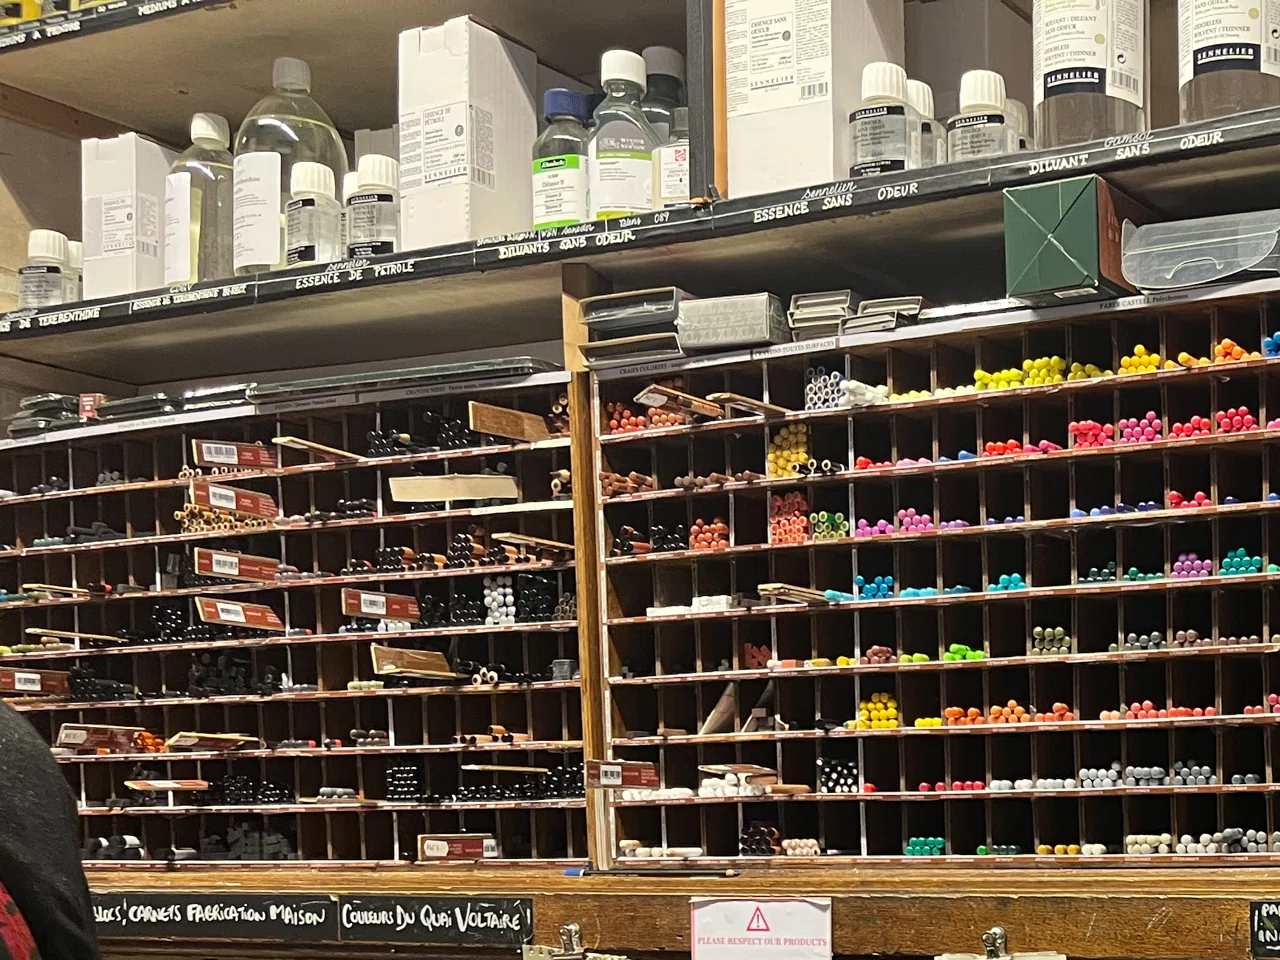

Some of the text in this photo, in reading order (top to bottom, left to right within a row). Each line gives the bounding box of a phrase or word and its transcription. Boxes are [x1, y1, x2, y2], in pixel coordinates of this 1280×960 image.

[1197, 47, 1254, 60] SENNELIER
[750, 75, 794, 87] SENNELIER
[1047, 71, 1099, 83] SENNELIER
[1028, 131, 1224, 175] DILUANT SANS ODEUR
[753, 182, 918, 223] ESSENCE SANS ODEUR
[499, 230, 636, 259] DILUANTS SANS ODEUR
[295, 273, 341, 289] ESSENCE
[349, 271, 363, 281] DE
[128, 904, 182, 922] CARNETS
[342, 903, 394, 928] COULEURS
[396, 904, 415, 931] DU
[697, 937, 827, 947] PLEASE RESPECT OUR PRODUCTS
